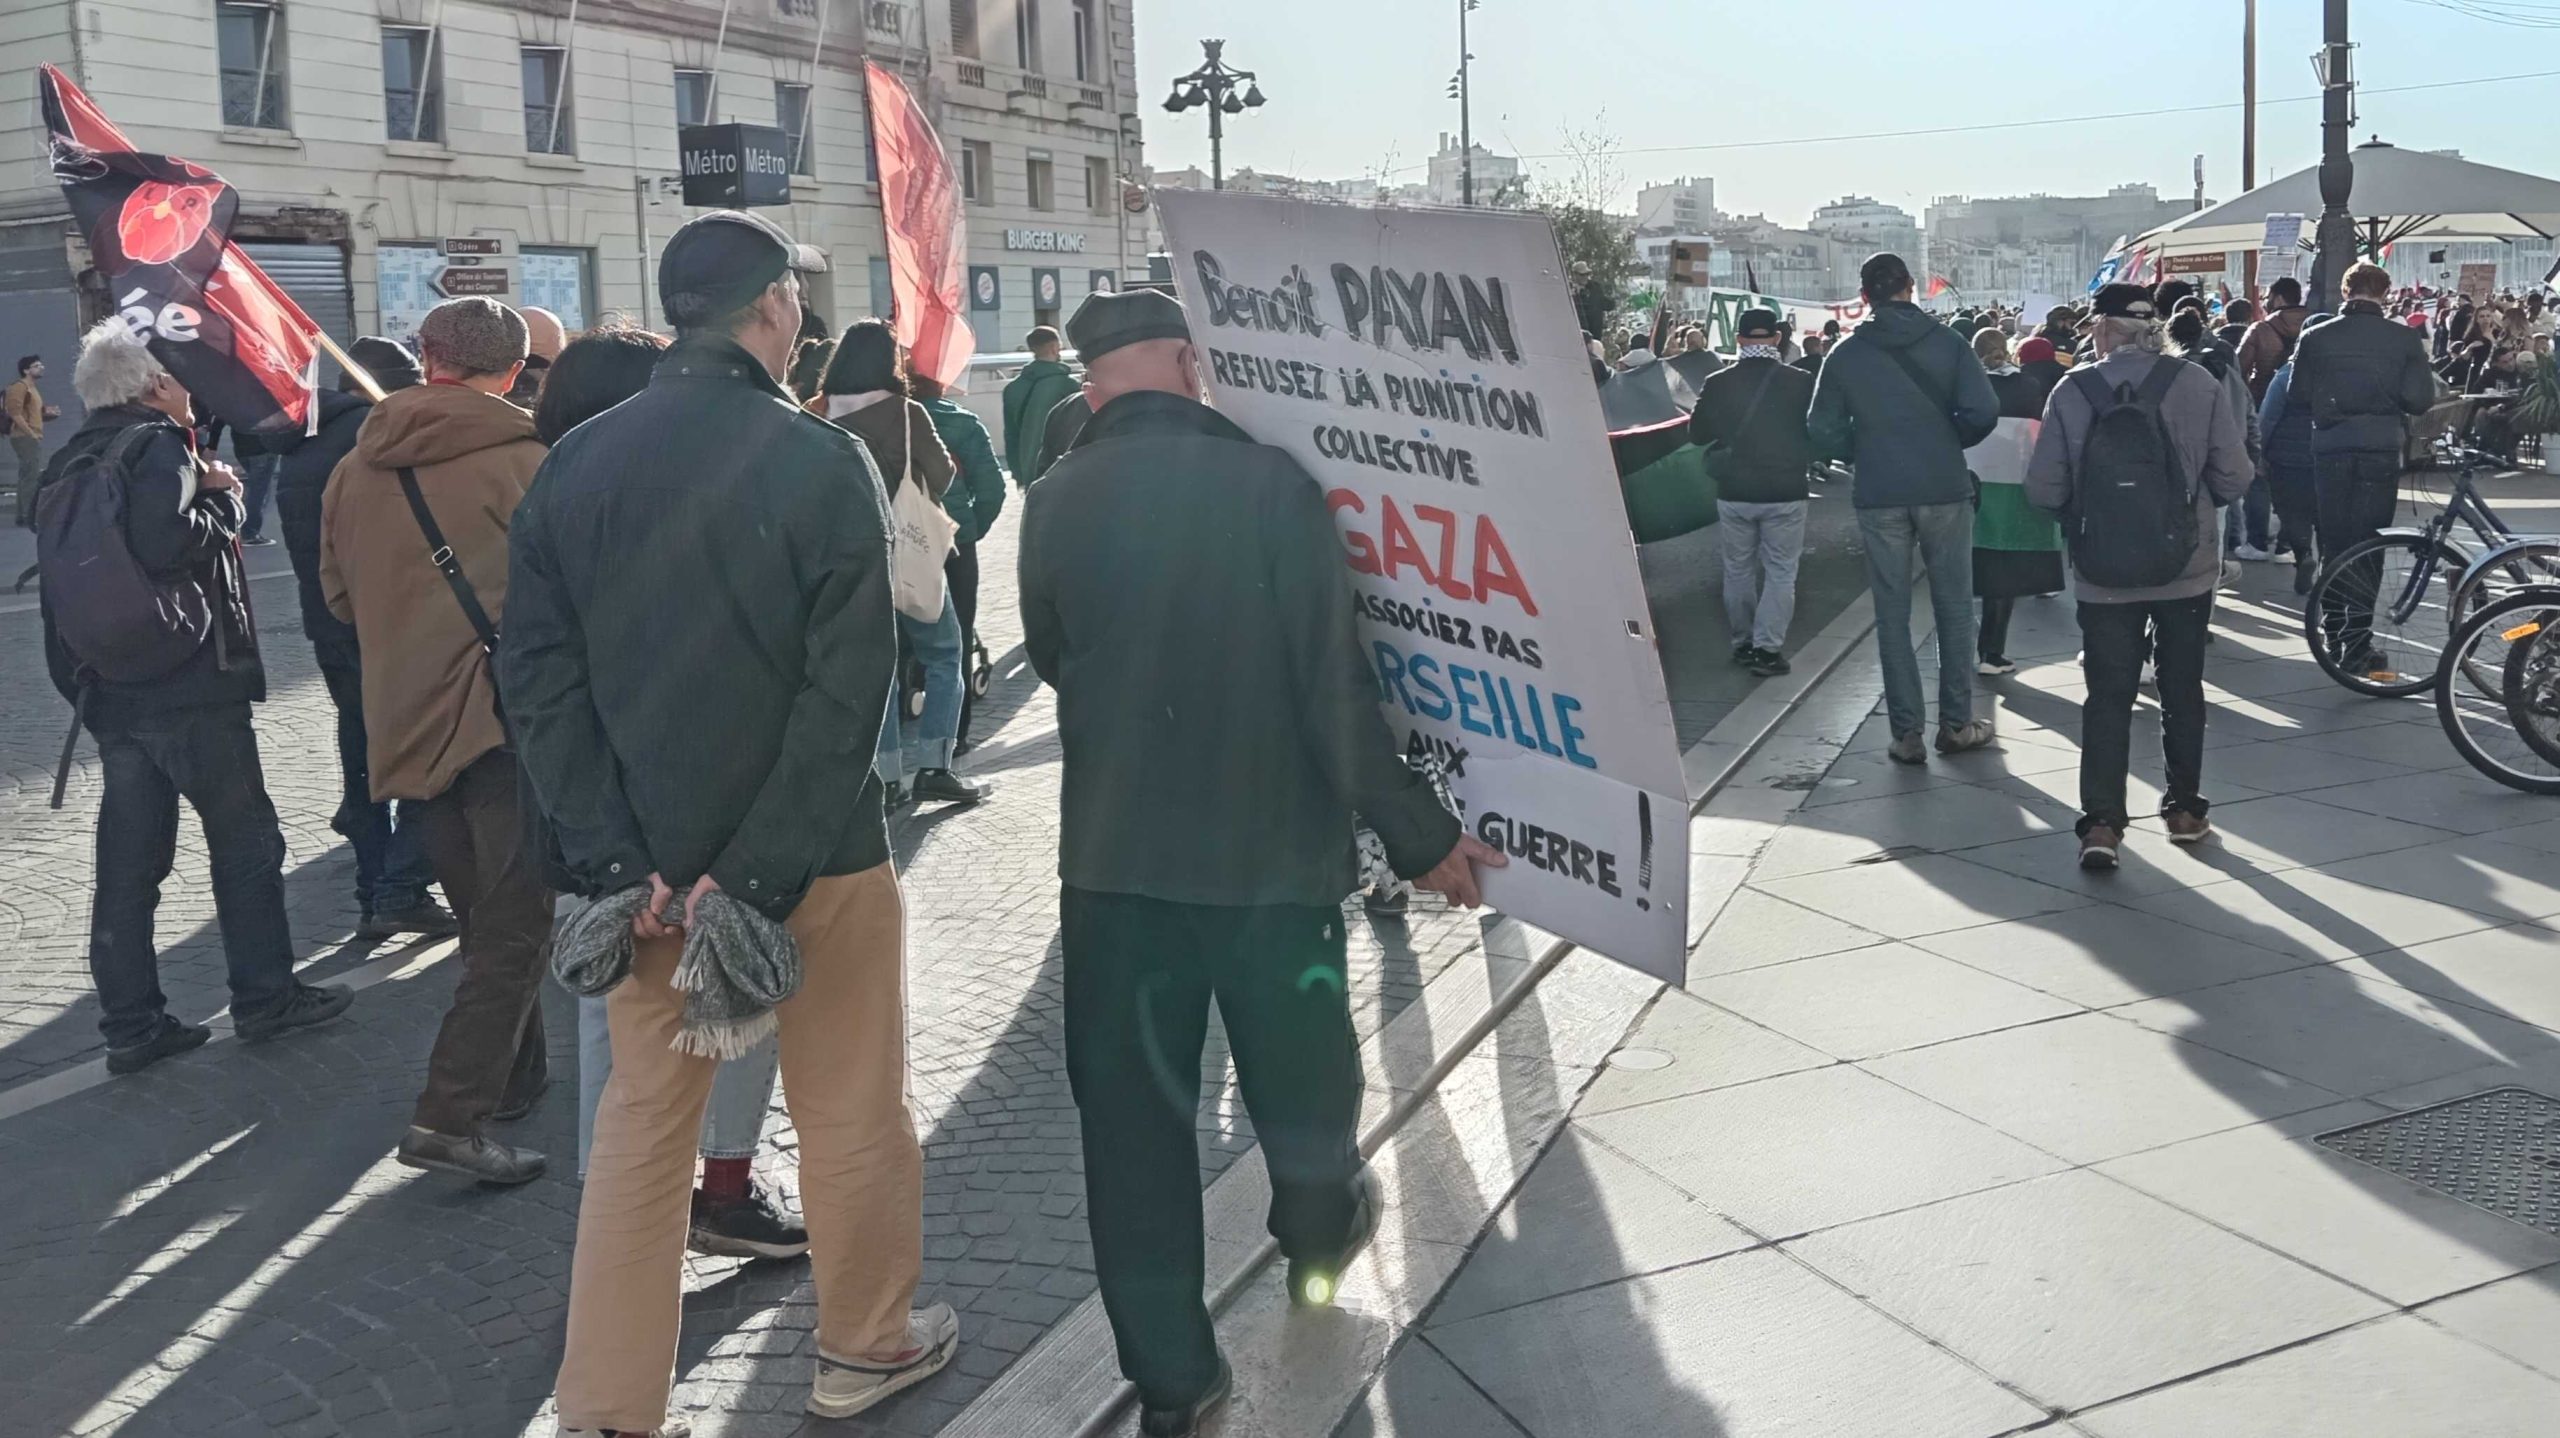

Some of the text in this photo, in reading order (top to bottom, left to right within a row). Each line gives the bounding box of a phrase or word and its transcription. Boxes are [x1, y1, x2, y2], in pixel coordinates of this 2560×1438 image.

[685, 149, 737, 176] Métro
[745, 147, 786, 175] Métro
[457, 241, 478, 251] Opéra
[1007, 230, 1086, 251] BURGER KING
[1331, 262, 1520, 365] PAYAN
[1209, 347, 1544, 438] REFUSEZ LA PUNITION
[1313, 425, 1480, 487] COLLECTIVE
[1327, 488, 1539, 617] GAZA
[1481, 625, 1543, 669] PAS
[1373, 640, 1598, 769] RSEILLE
[1406, 729, 1470, 778] AUX
[1477, 811, 1623, 898] GUERRE
